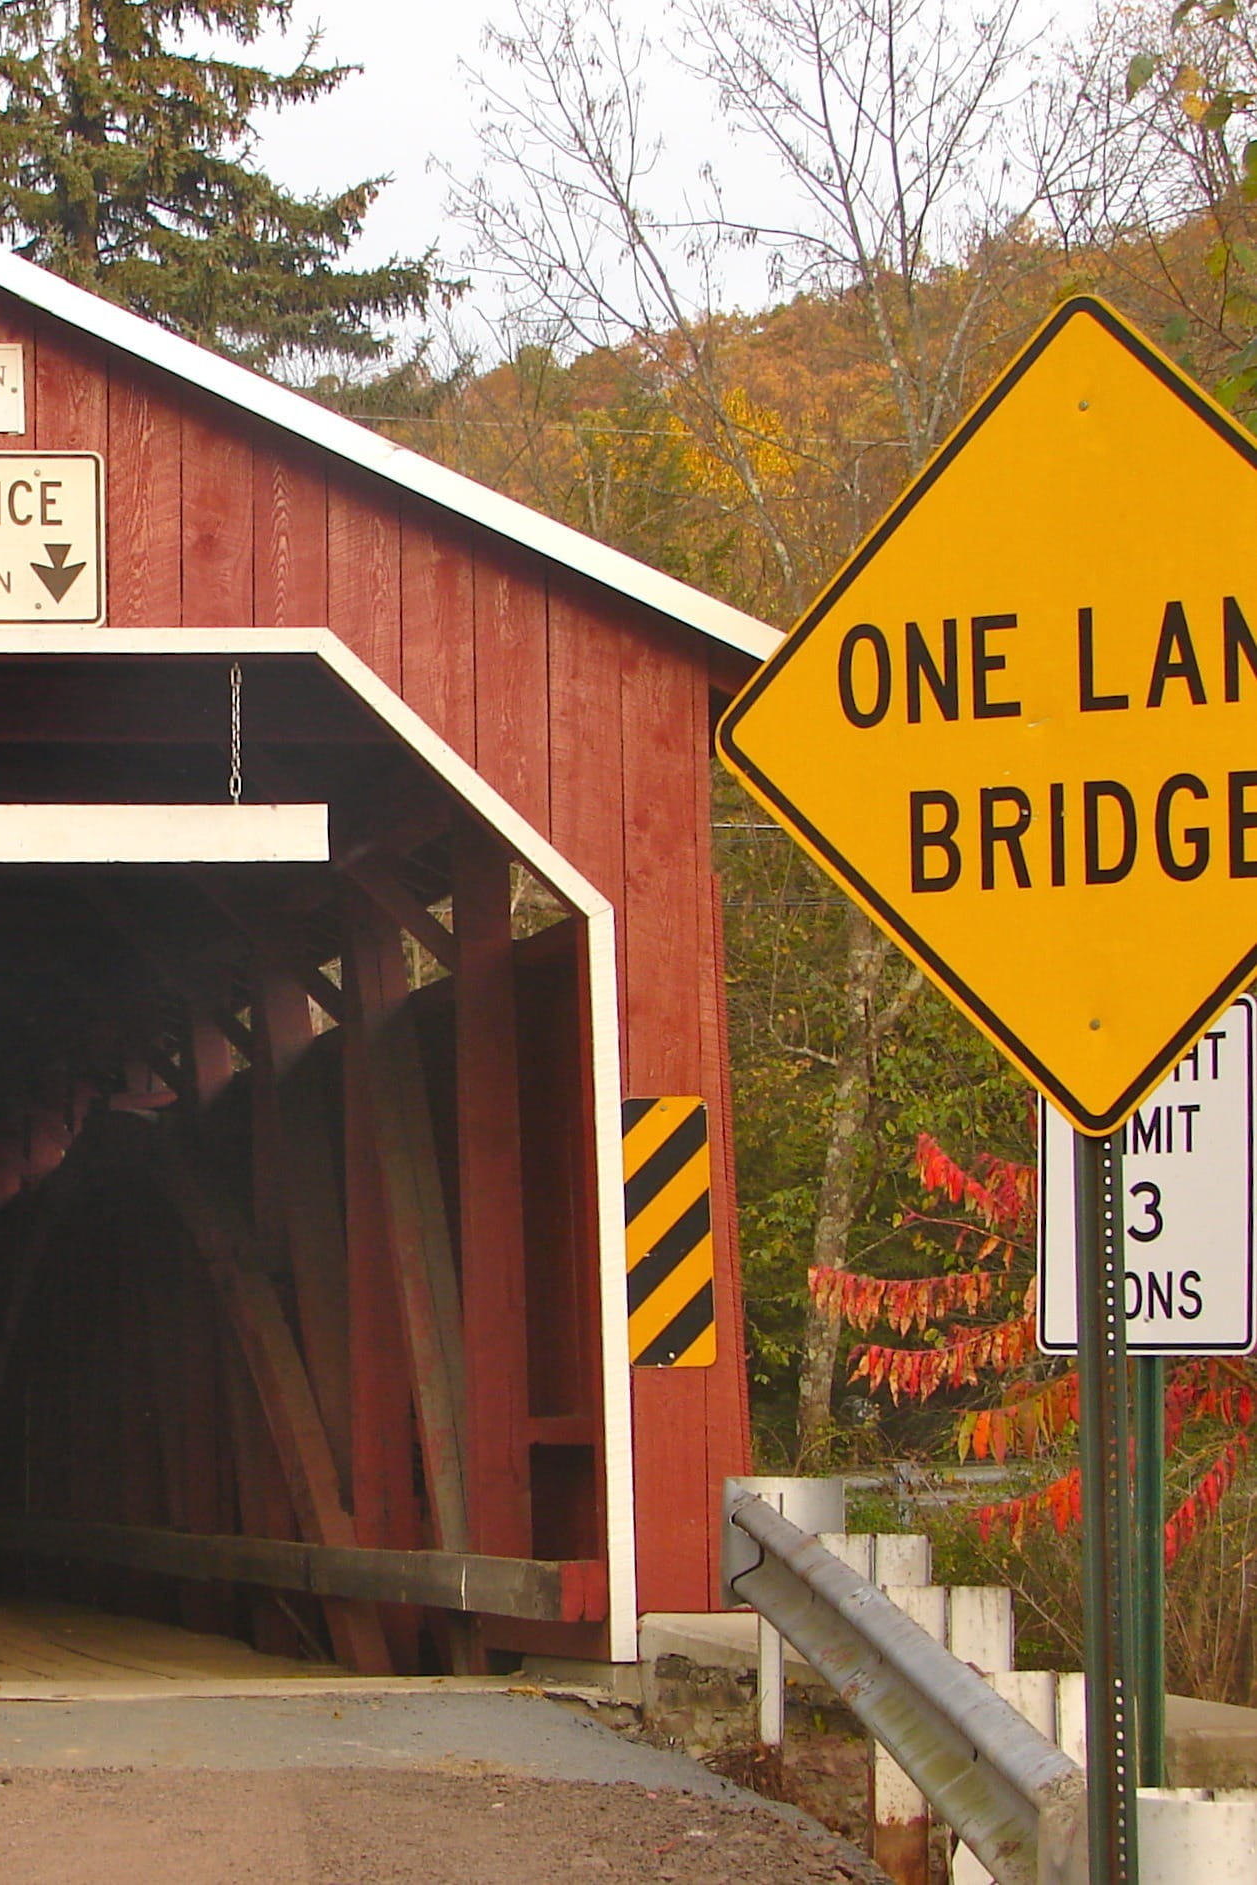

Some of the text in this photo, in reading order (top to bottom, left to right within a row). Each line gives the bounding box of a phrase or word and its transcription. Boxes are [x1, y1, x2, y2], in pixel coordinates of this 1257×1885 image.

[837, 595, 1257, 729] ONE LAN
[909, 770, 1257, 893] BRIDGE
[1173, 1031, 1227, 1082] HT
[1122, 1104, 1201, 1155] IMIT
[1127, 1181, 1164, 1243] 3
[1124, 1270, 1203, 1320] ONS
